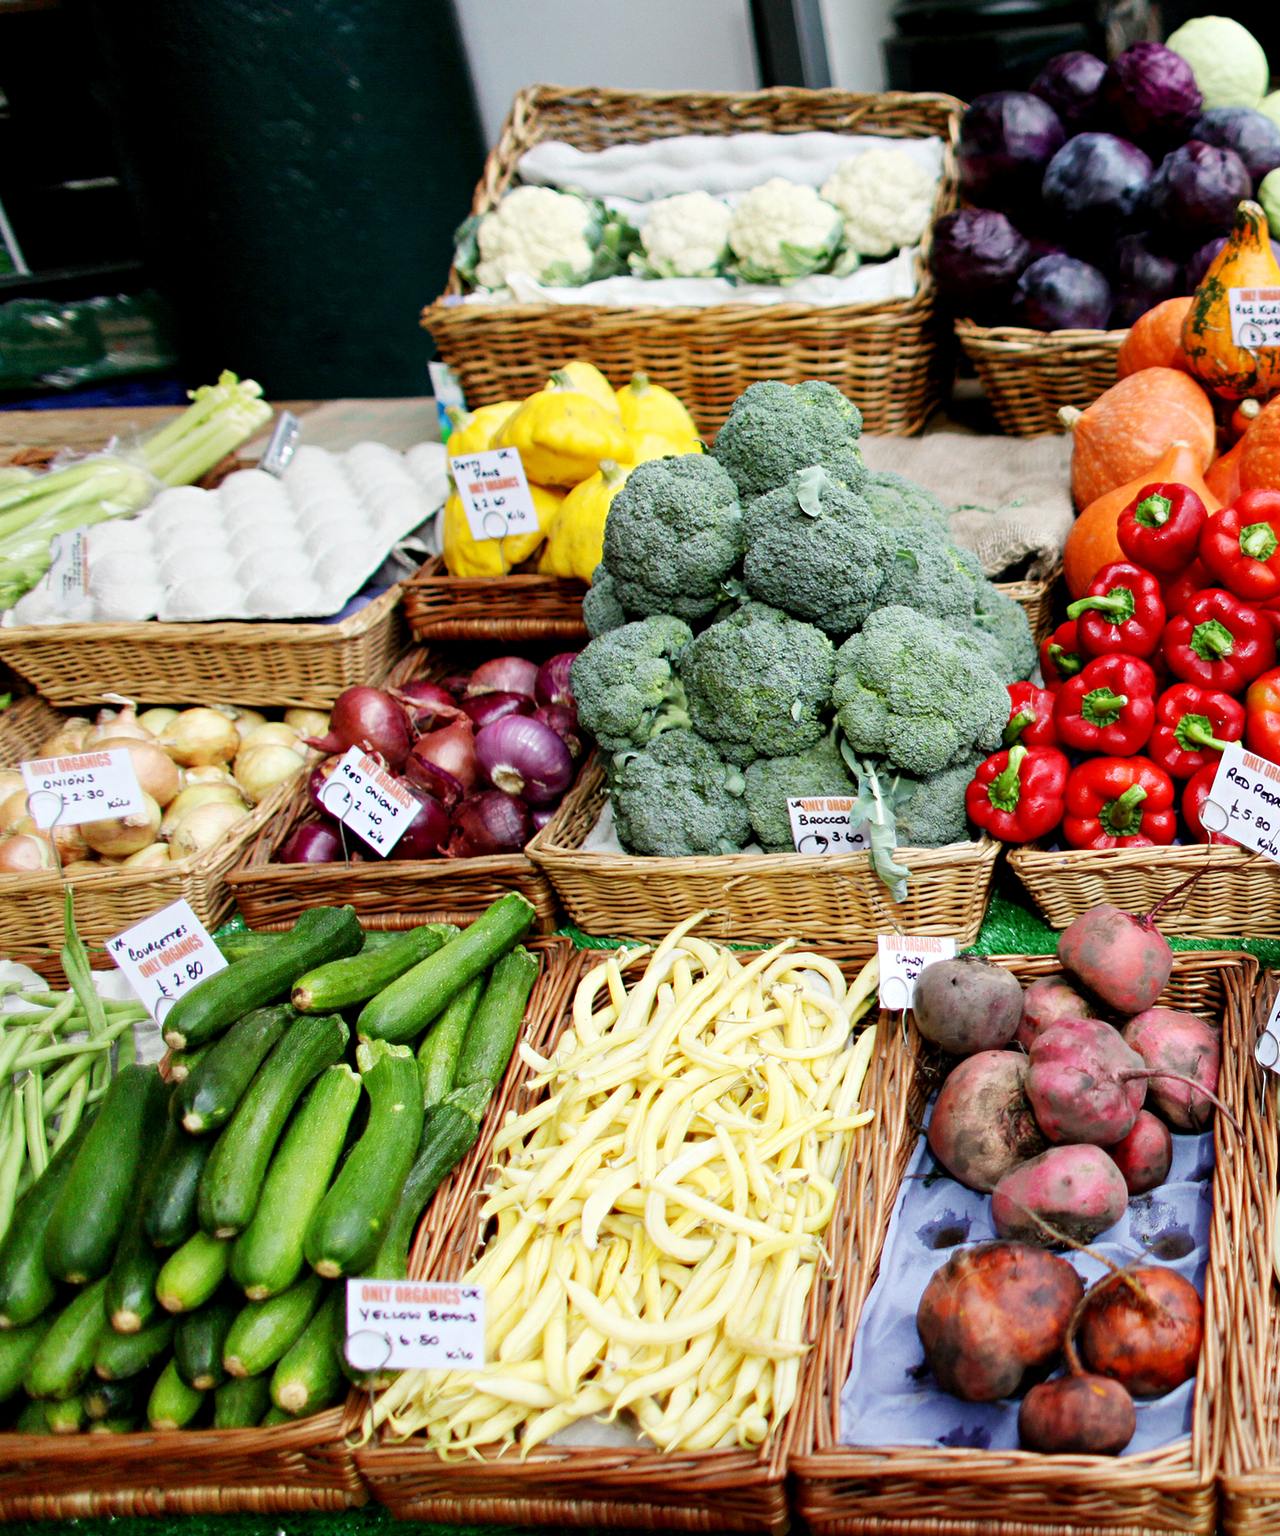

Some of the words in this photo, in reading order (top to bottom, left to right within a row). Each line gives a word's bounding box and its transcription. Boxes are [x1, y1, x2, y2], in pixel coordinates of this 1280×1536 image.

[30, 760, 56, 777] ONLY
[56, 752, 112, 773] ORGANICS
[1241, 752, 1266, 774] ONLY
[357, 754, 382, 777] ONLY
[375, 770, 415, 809] ORGANICS
[1226, 767, 1250, 790] RED
[801, 799, 825, 812] ONLY
[826, 799, 853, 812] ORGA
[138, 956, 163, 979] ONLY
[158, 932, 205, 967] ORGANICS
[885, 936, 904, 951] ONLY
[904, 937, 943, 953] ORGANICS
[362, 1285, 392, 1303] ONLY
[394, 1286, 462, 1305] ORGANICS
